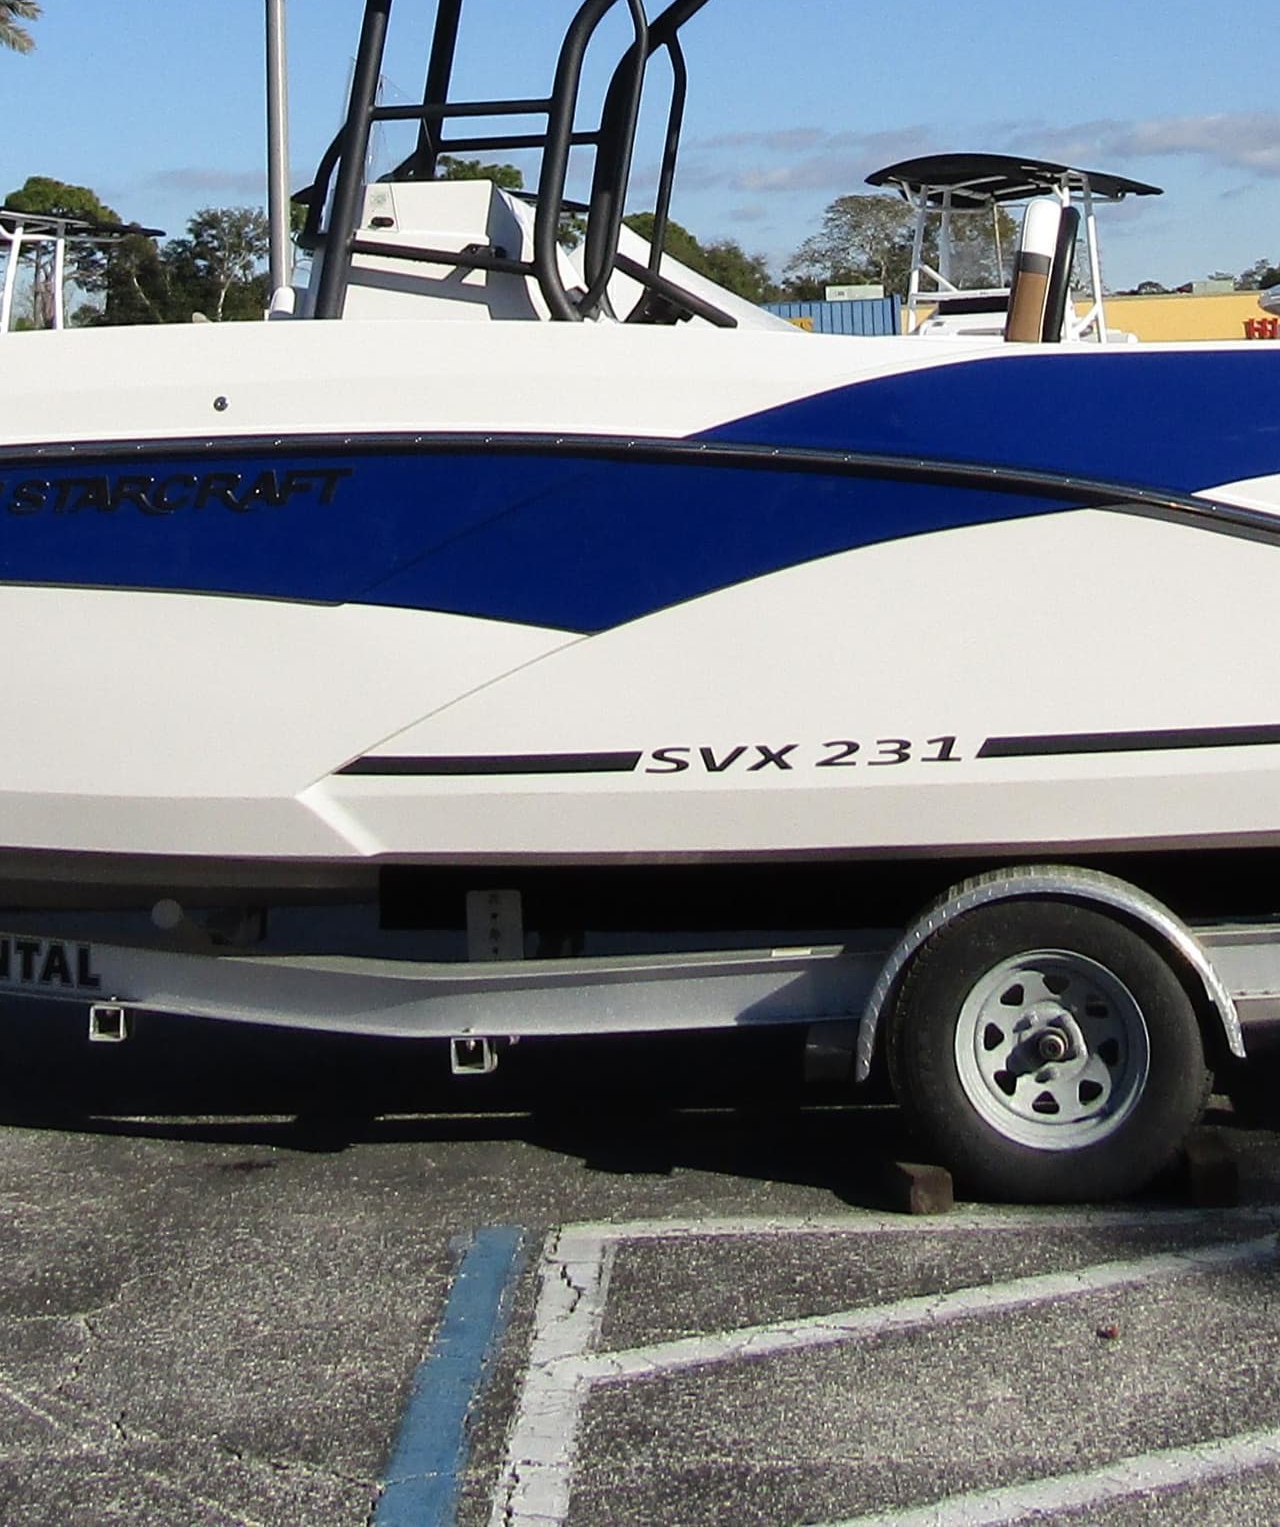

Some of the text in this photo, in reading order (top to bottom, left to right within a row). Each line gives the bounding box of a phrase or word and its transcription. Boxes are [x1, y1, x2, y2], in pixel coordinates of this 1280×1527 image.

[9, 467, 353, 515] STARCRAFT
[645, 736, 962, 773] SVX 231
